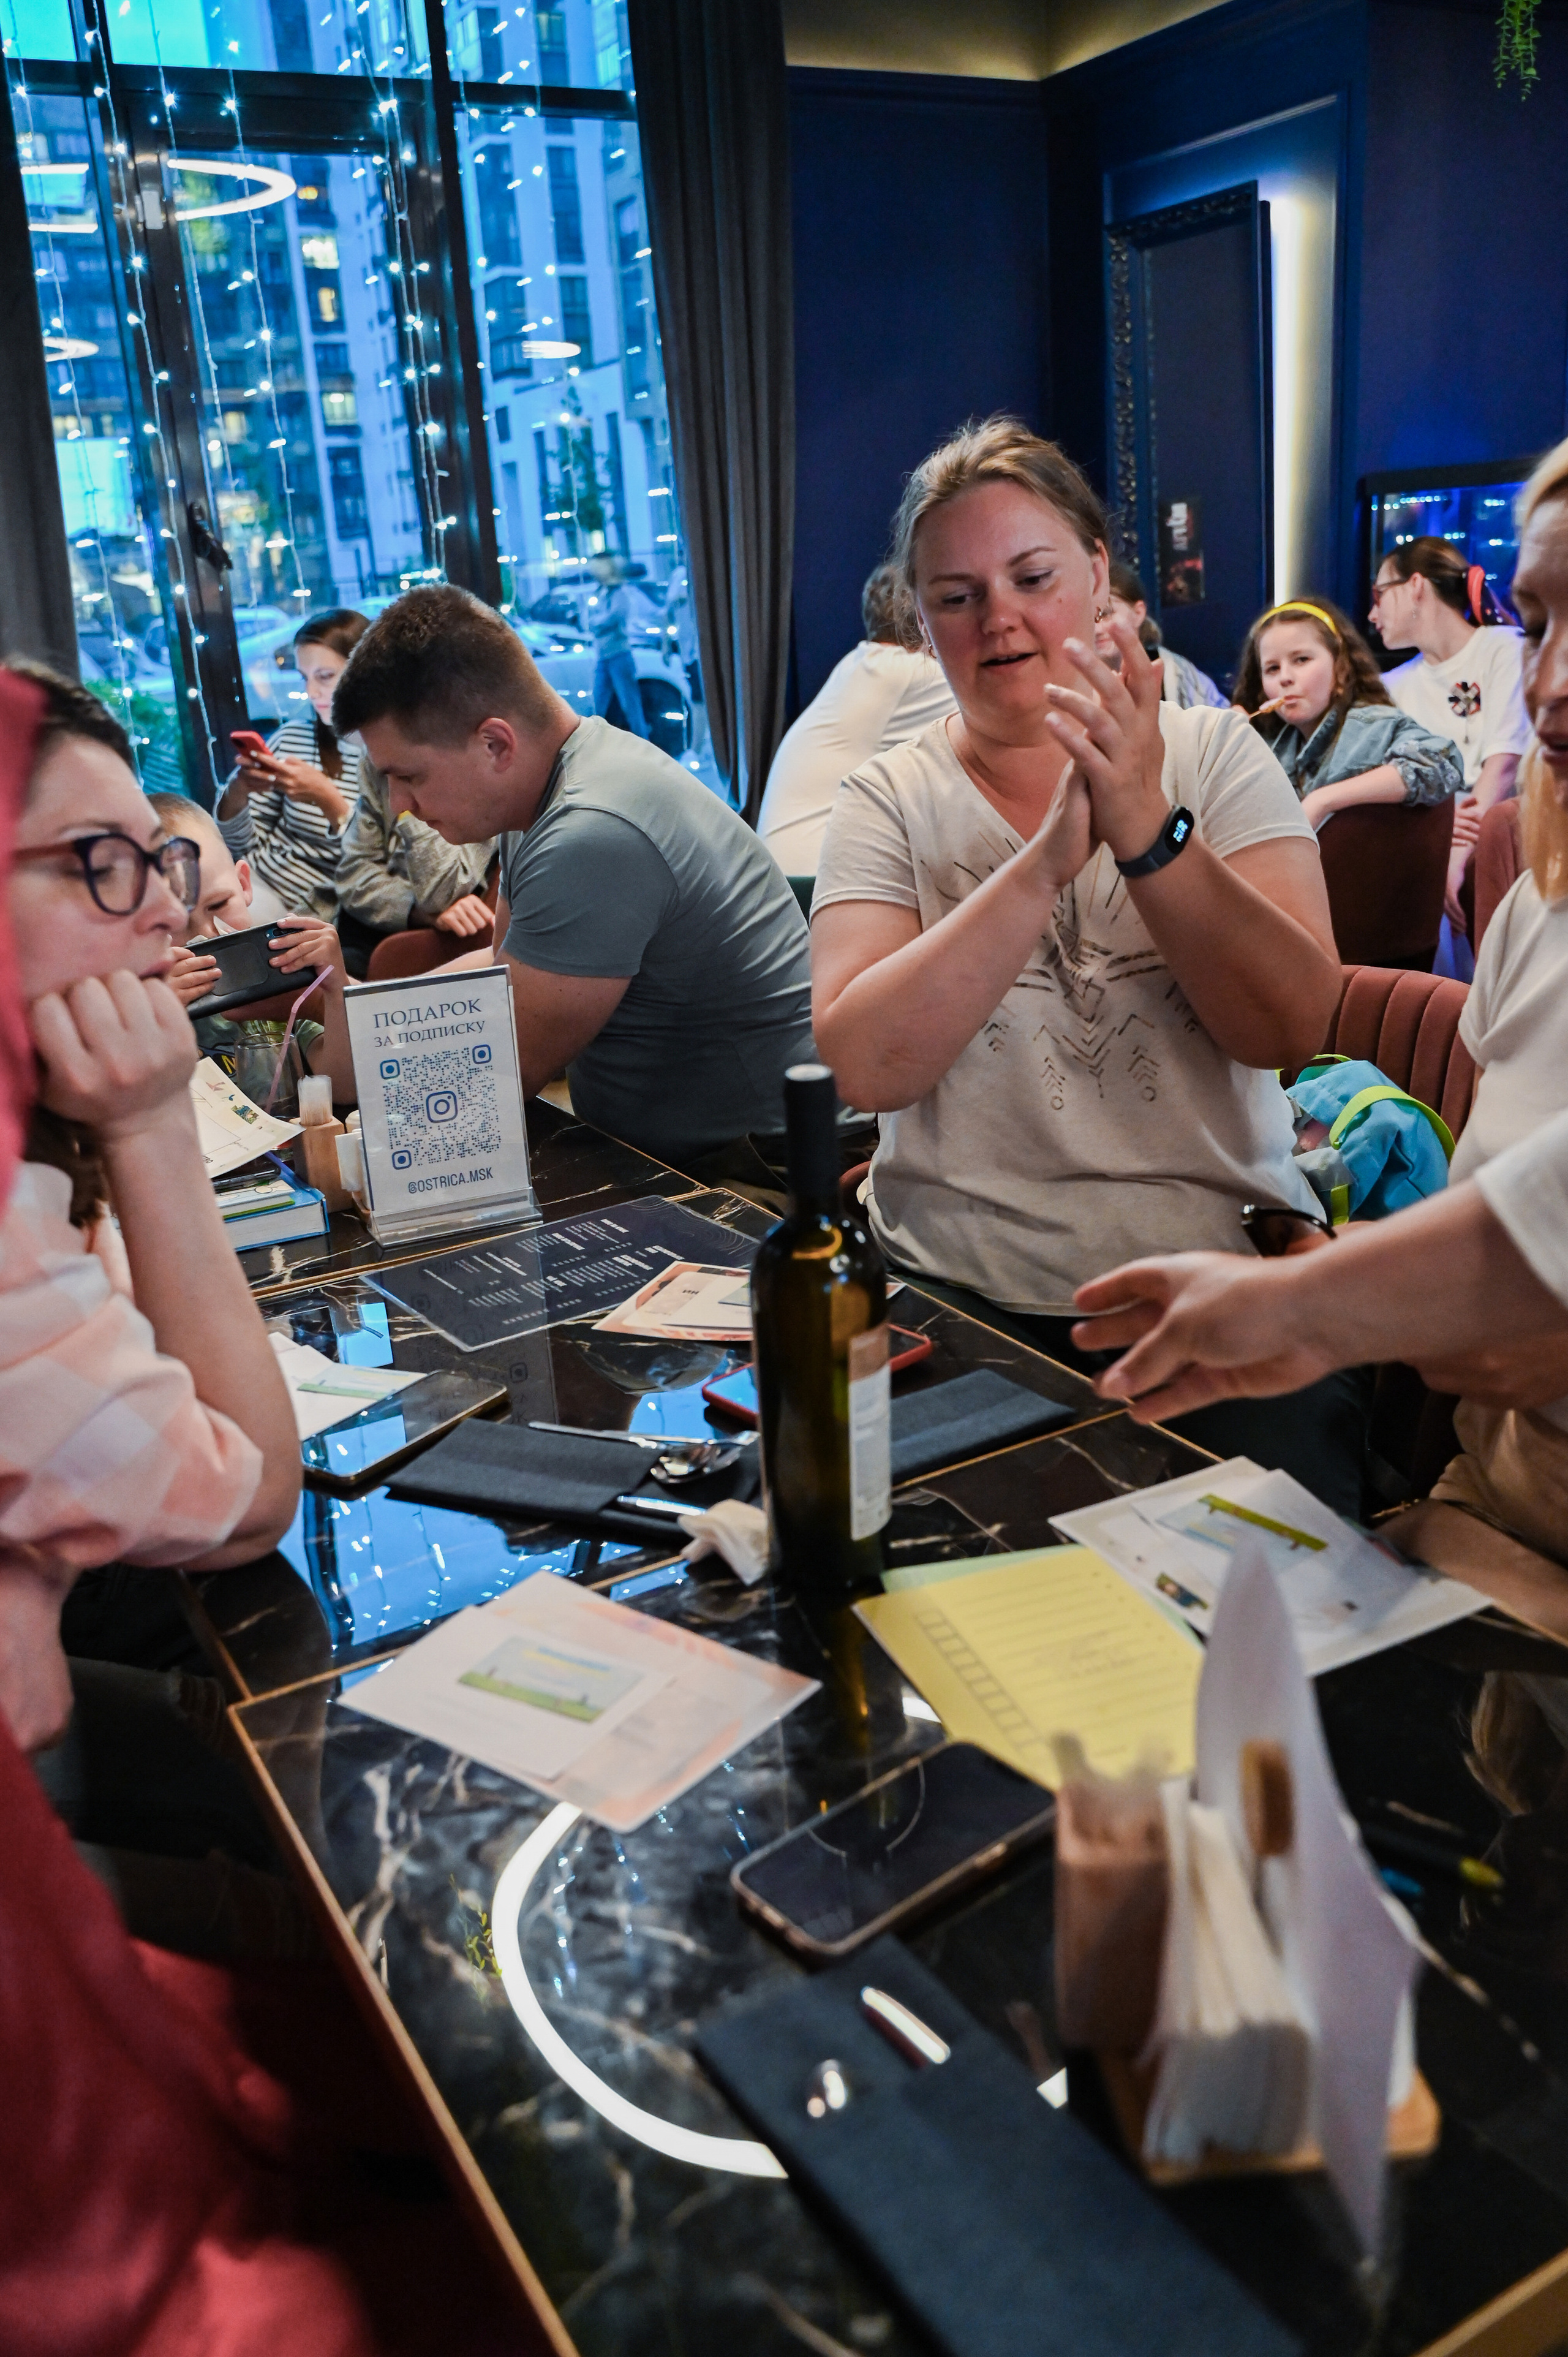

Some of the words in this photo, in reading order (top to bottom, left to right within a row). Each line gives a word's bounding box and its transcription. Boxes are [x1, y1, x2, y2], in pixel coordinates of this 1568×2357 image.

[373, 998, 483, 1029] ПОДАРОК
[374, 1035, 394, 1048] ЗА
[398, 1020, 485, 1044] ПОДПИСКУ
[408, 1167, 494, 1194] @OSTRICA.MSK
